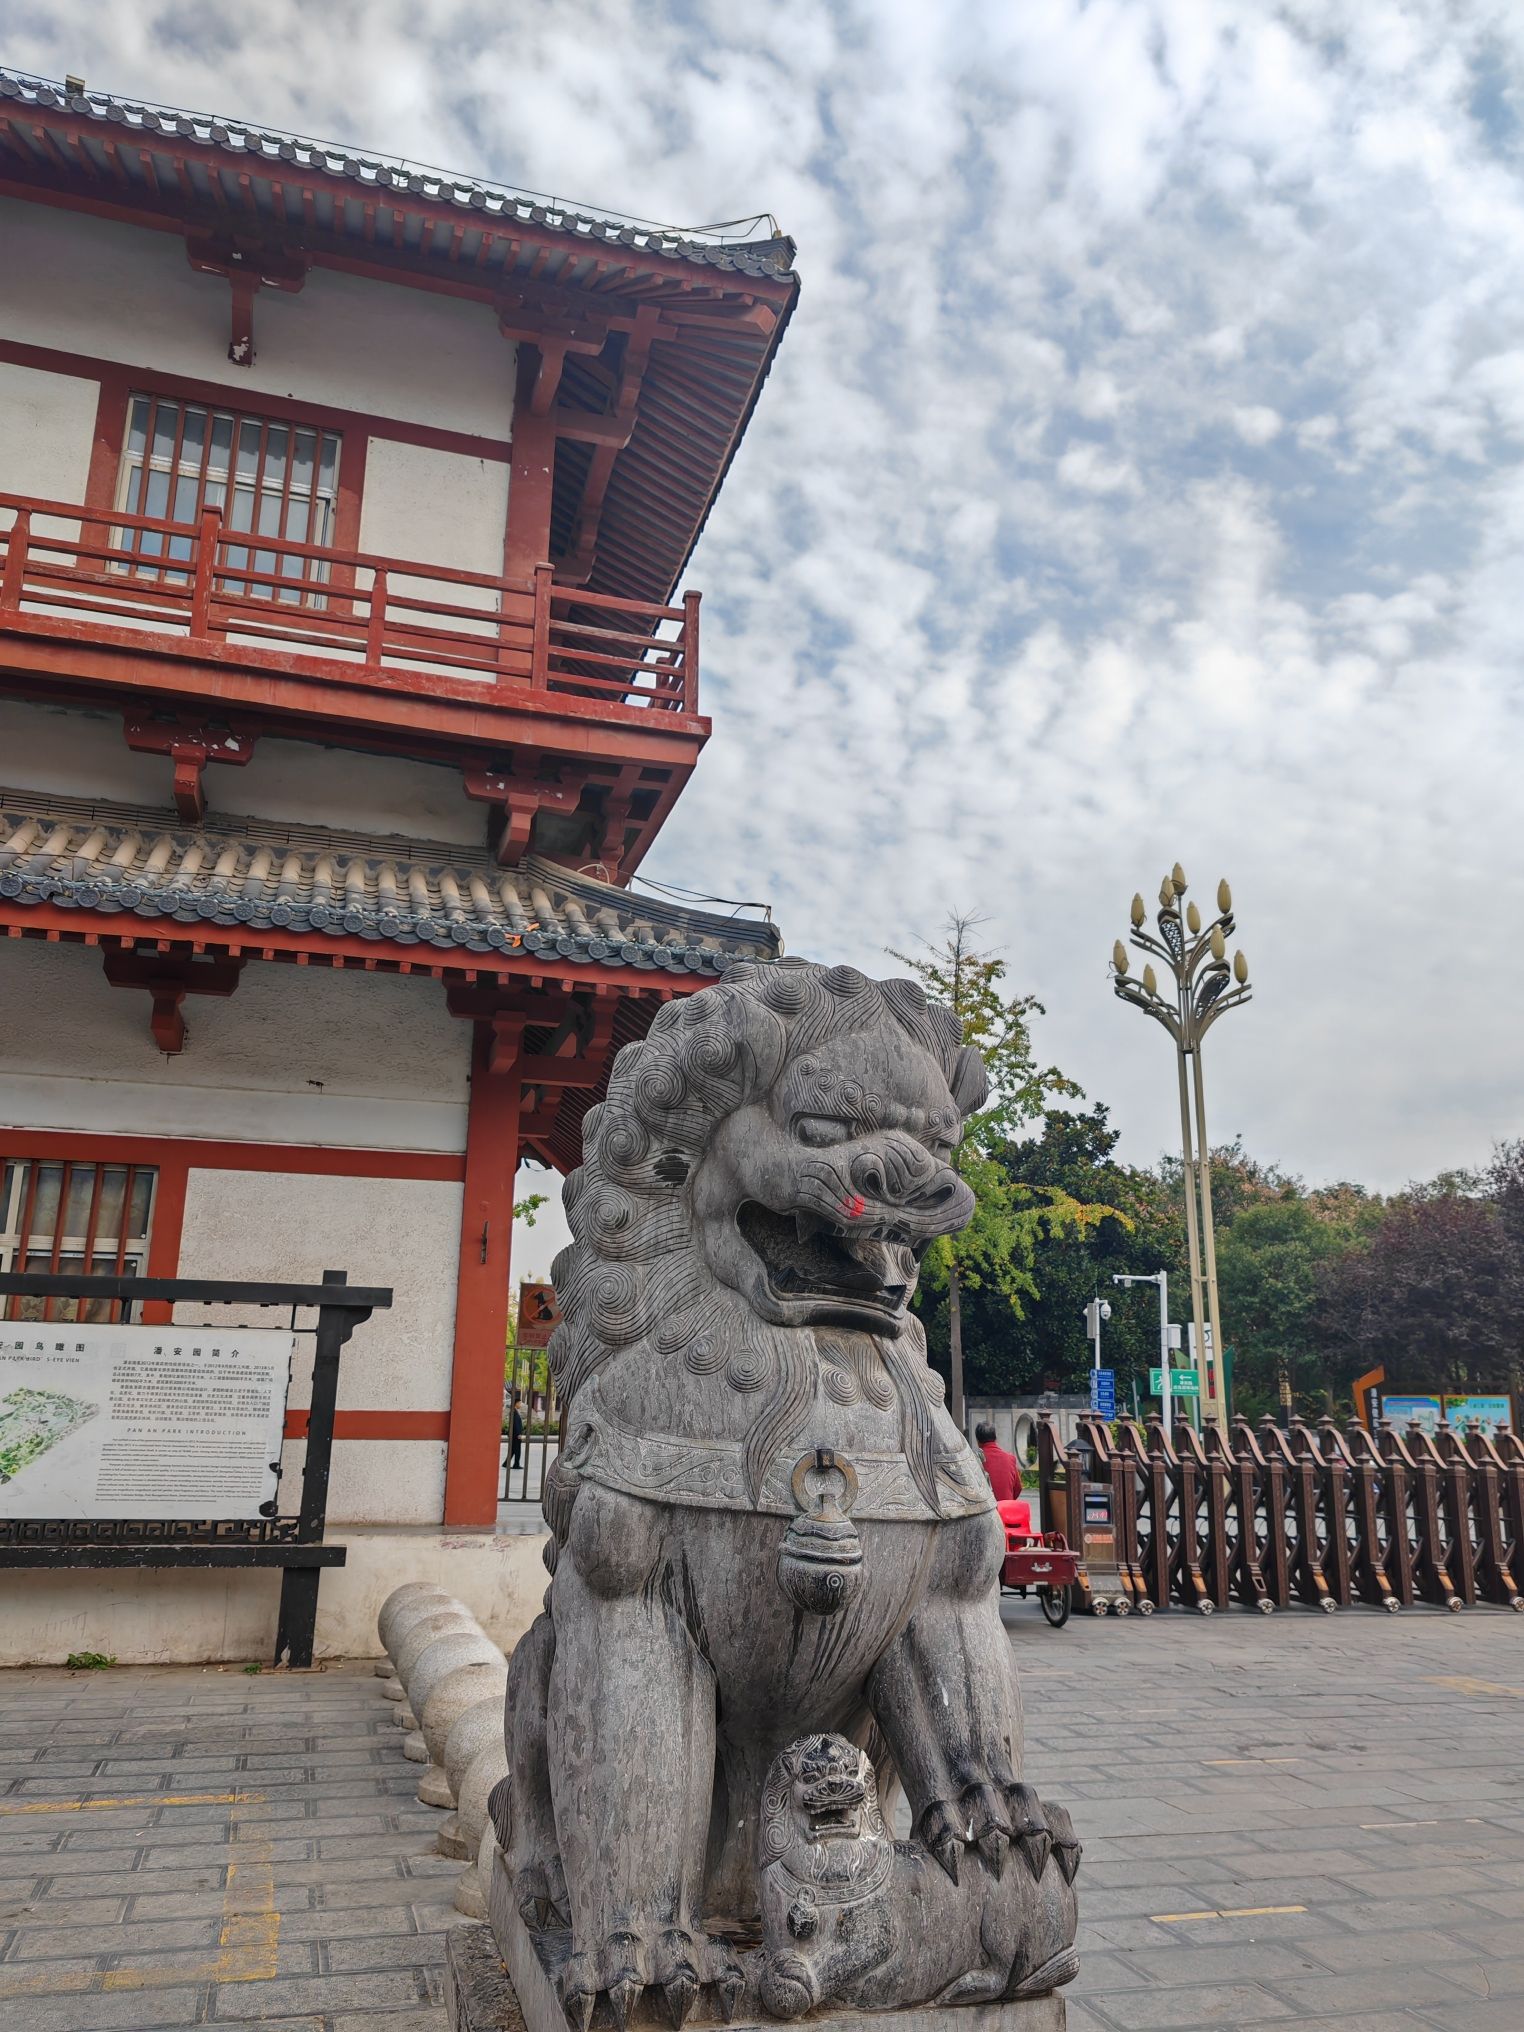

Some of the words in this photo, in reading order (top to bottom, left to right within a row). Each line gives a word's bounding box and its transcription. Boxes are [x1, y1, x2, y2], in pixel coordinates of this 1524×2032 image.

[153, 1346, 239, 1358] 潘安园简介
